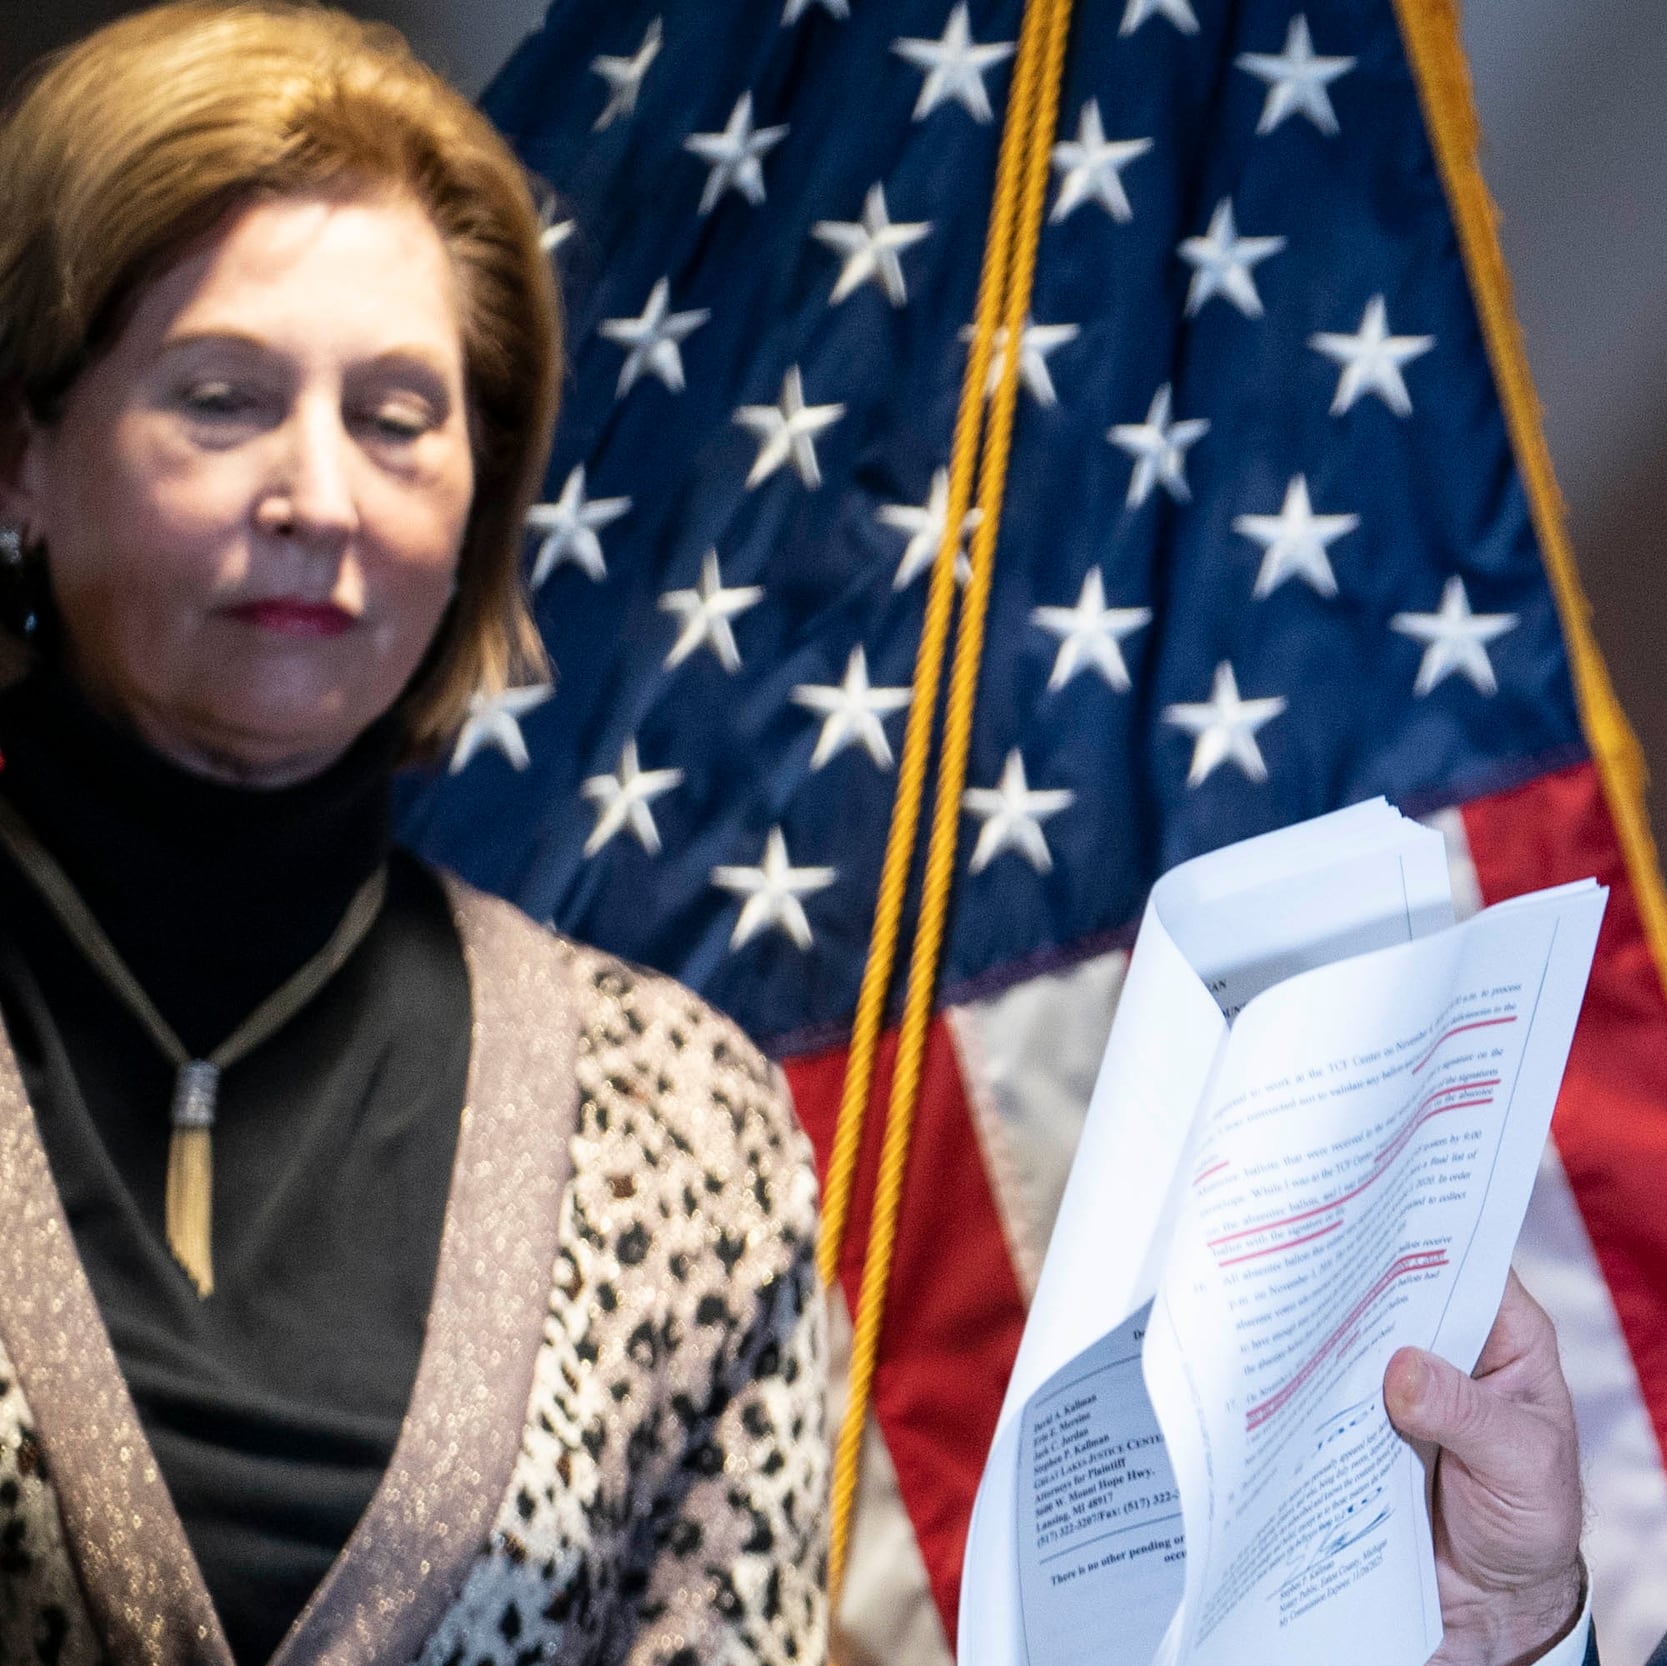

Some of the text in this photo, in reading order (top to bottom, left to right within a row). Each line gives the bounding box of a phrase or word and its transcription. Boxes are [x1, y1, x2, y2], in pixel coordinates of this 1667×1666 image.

[1064, 1394, 1097, 1415] Kallman
[1034, 1455, 1062, 1475] Stephen
[1074, 1434, 1110, 1456] Kallman
[1062, 1427, 1089, 1448] Jordan
[1035, 1457, 1126, 1503] Attorneys for Plaintiff
[1061, 1460, 1087, 1477] LAKES
[1088, 1445, 1123, 1465] JUSTICE
[1068, 1484, 1097, 1503] Mount
[1099, 1475, 1125, 1491] Hope
[1127, 1467, 1155, 1481] Hwy.
[1036, 1491, 1114, 1533] Lansing, MI 48917
[1037, 1529, 1059, 1550] (517)
[1123, 1496, 1152, 1516] (517)
[1051, 1570, 1077, 1587] There
[1088, 1562, 1100, 1572] no
[1101, 1550, 1126, 1566] other
[1129, 1537, 1172, 1561] pending
[1174, 1535, 1185, 1545] or
